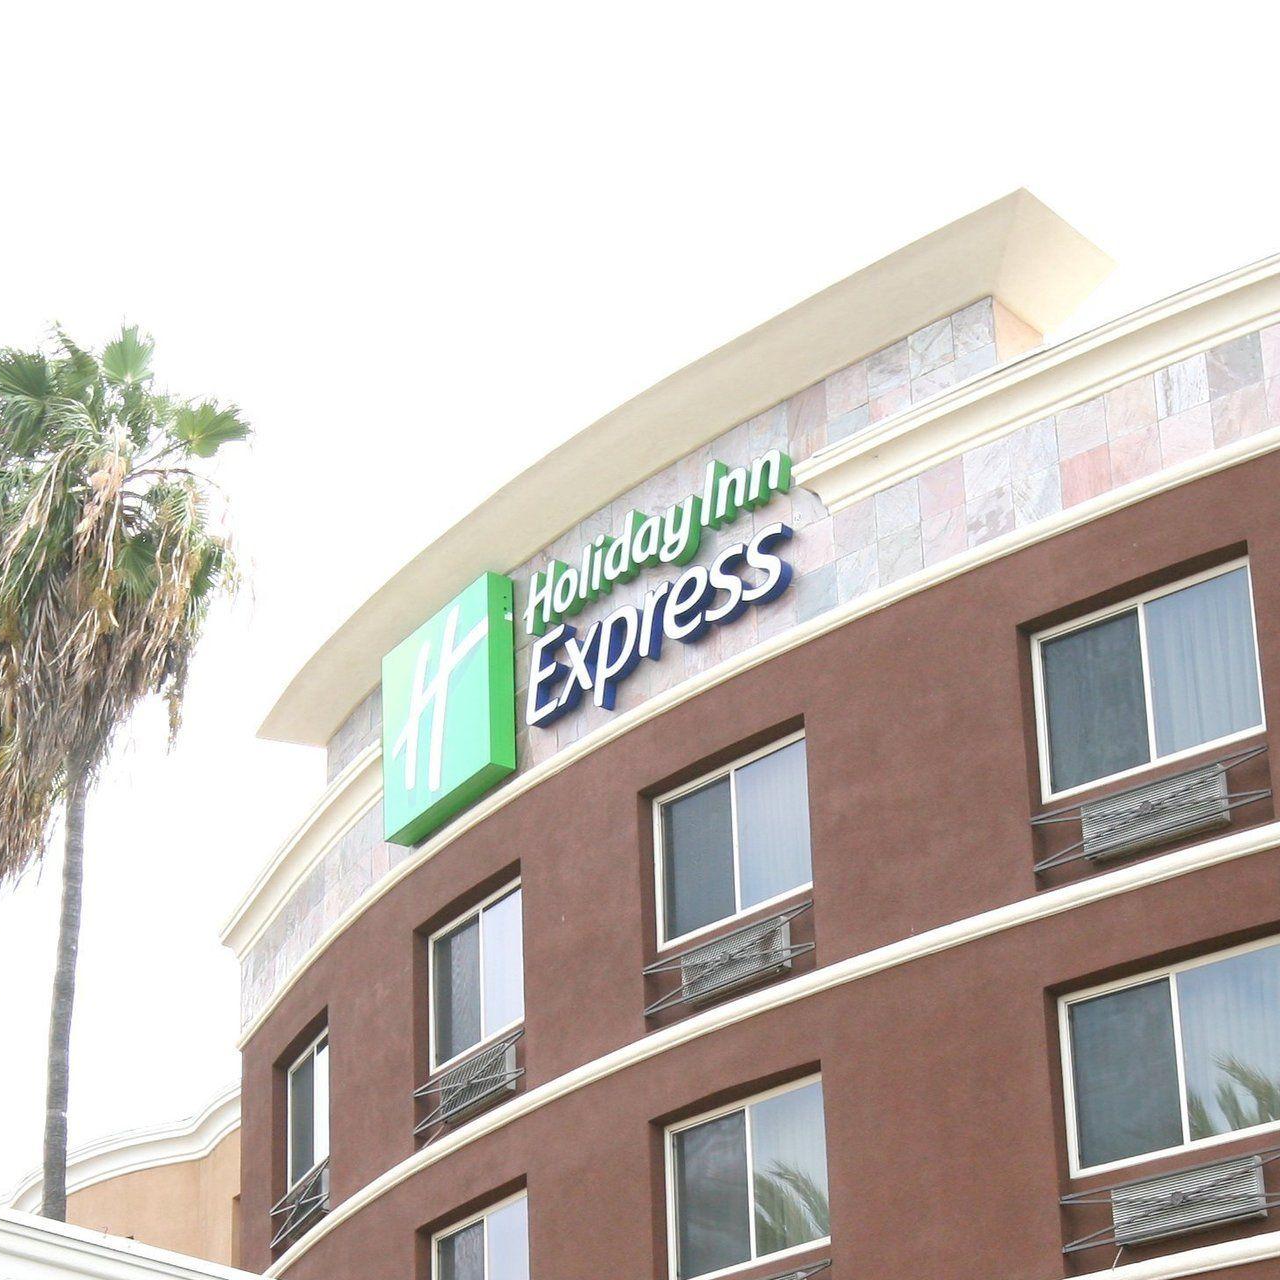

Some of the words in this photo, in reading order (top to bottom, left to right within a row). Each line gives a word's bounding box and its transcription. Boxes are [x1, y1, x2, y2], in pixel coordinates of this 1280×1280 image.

[523, 494, 701, 637] Holiday
[700, 448, 792, 531] Inn
[526, 522, 793, 728] Express
